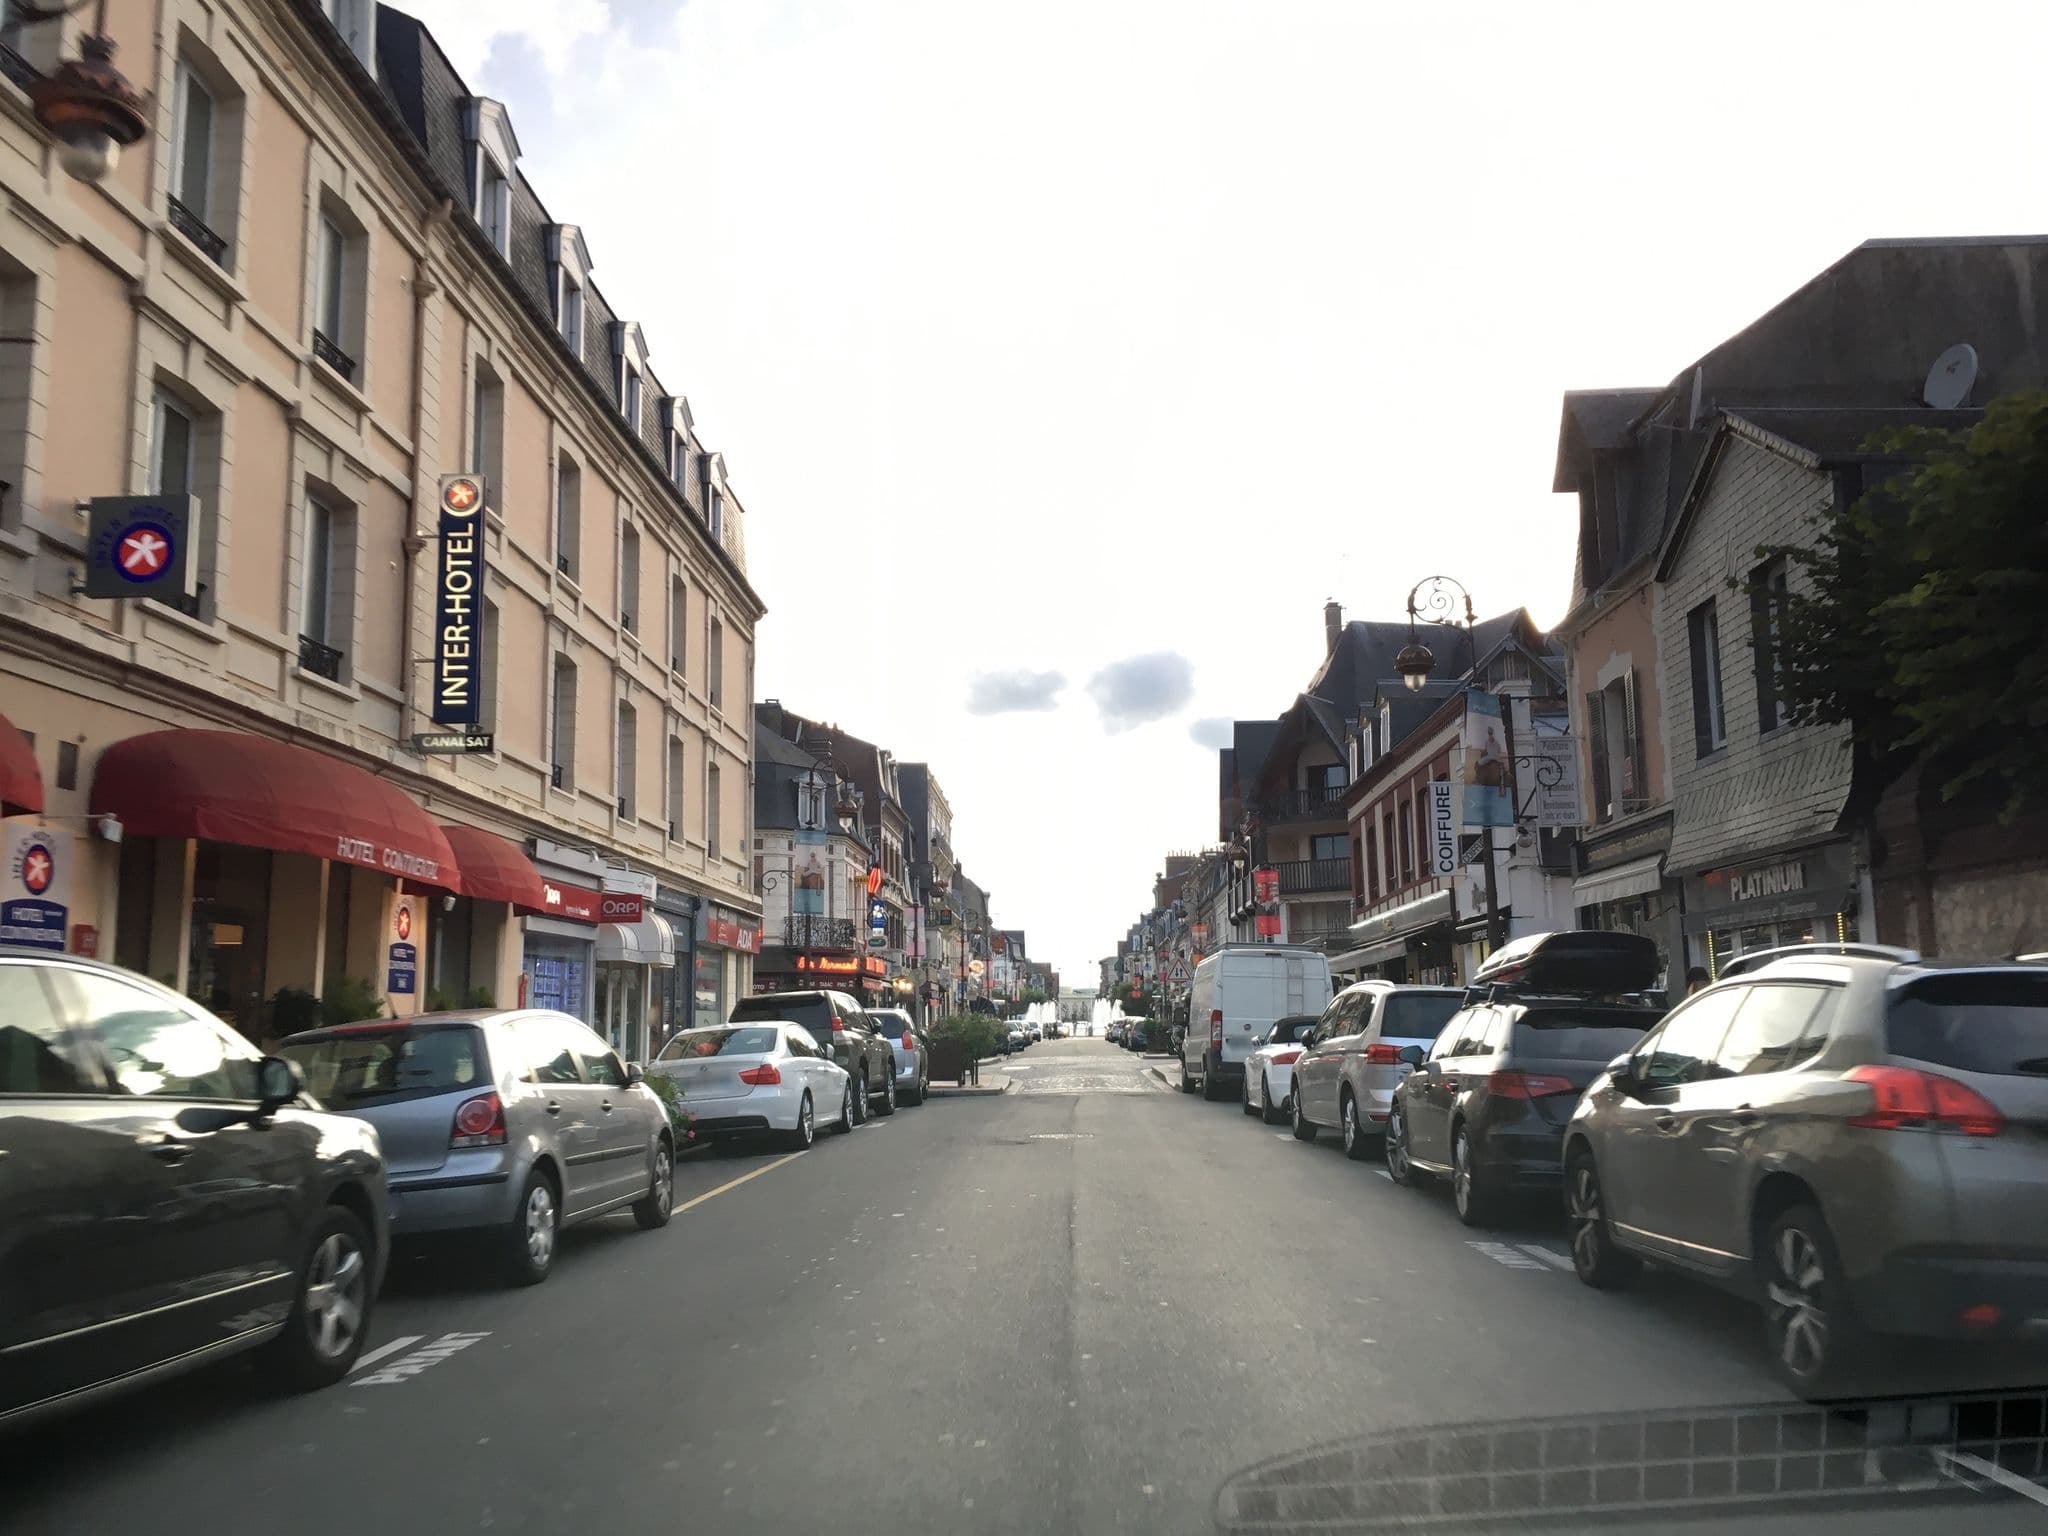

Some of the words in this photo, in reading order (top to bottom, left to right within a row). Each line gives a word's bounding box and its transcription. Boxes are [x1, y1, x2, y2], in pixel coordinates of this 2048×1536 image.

[441, 522, 474, 705] INTER-HOTEL
[421, 734, 490, 748] CANALSAT
[1436, 785, 1454, 873] COIFFURE
[337, 836, 376, 864] HOTEL
[383, 848, 438, 880] CONTINENTAL
[1731, 863, 1804, 901] PLATINIUM
[603, 901, 640, 914] ORPI
[736, 929, 752, 950] ADA
